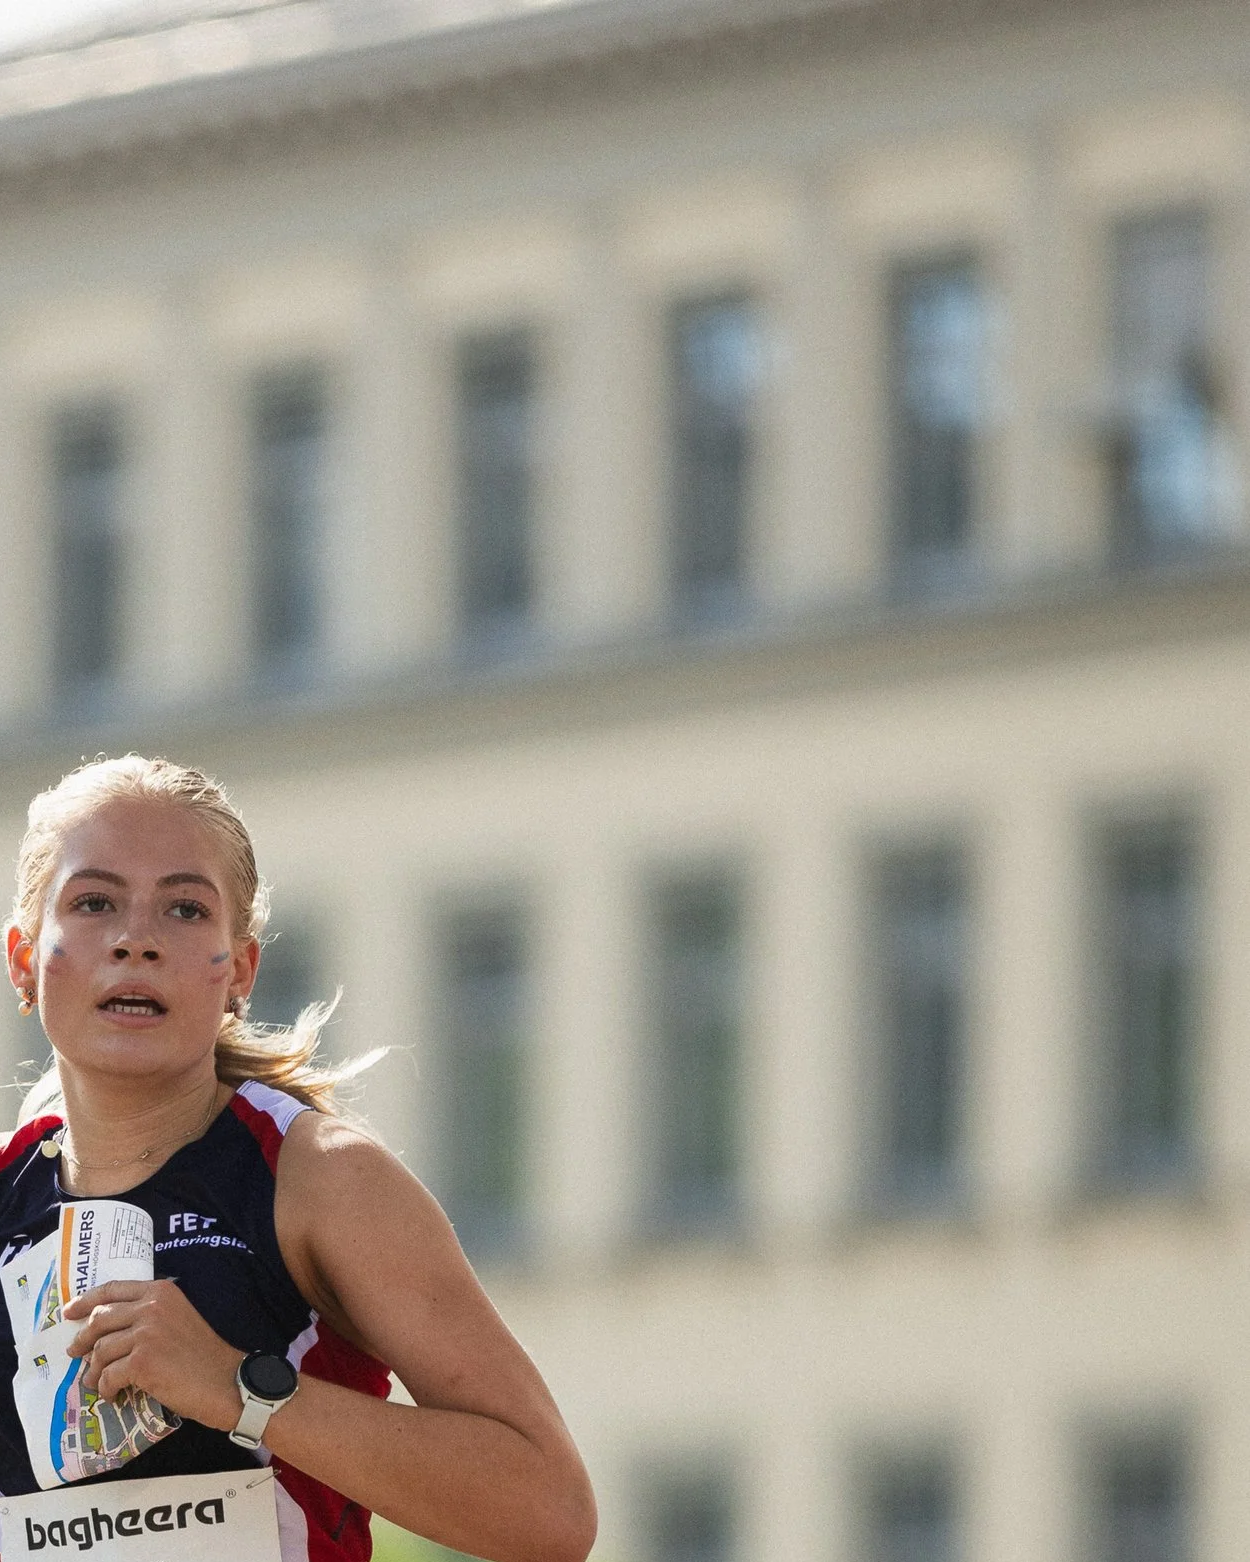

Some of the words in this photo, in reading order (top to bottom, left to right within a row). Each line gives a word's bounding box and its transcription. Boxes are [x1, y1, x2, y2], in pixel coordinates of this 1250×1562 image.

[169, 1212, 217, 1234] FET
[154, 1235, 254, 1254] enteringsla
[25, 1498, 225, 1551] bagheera
